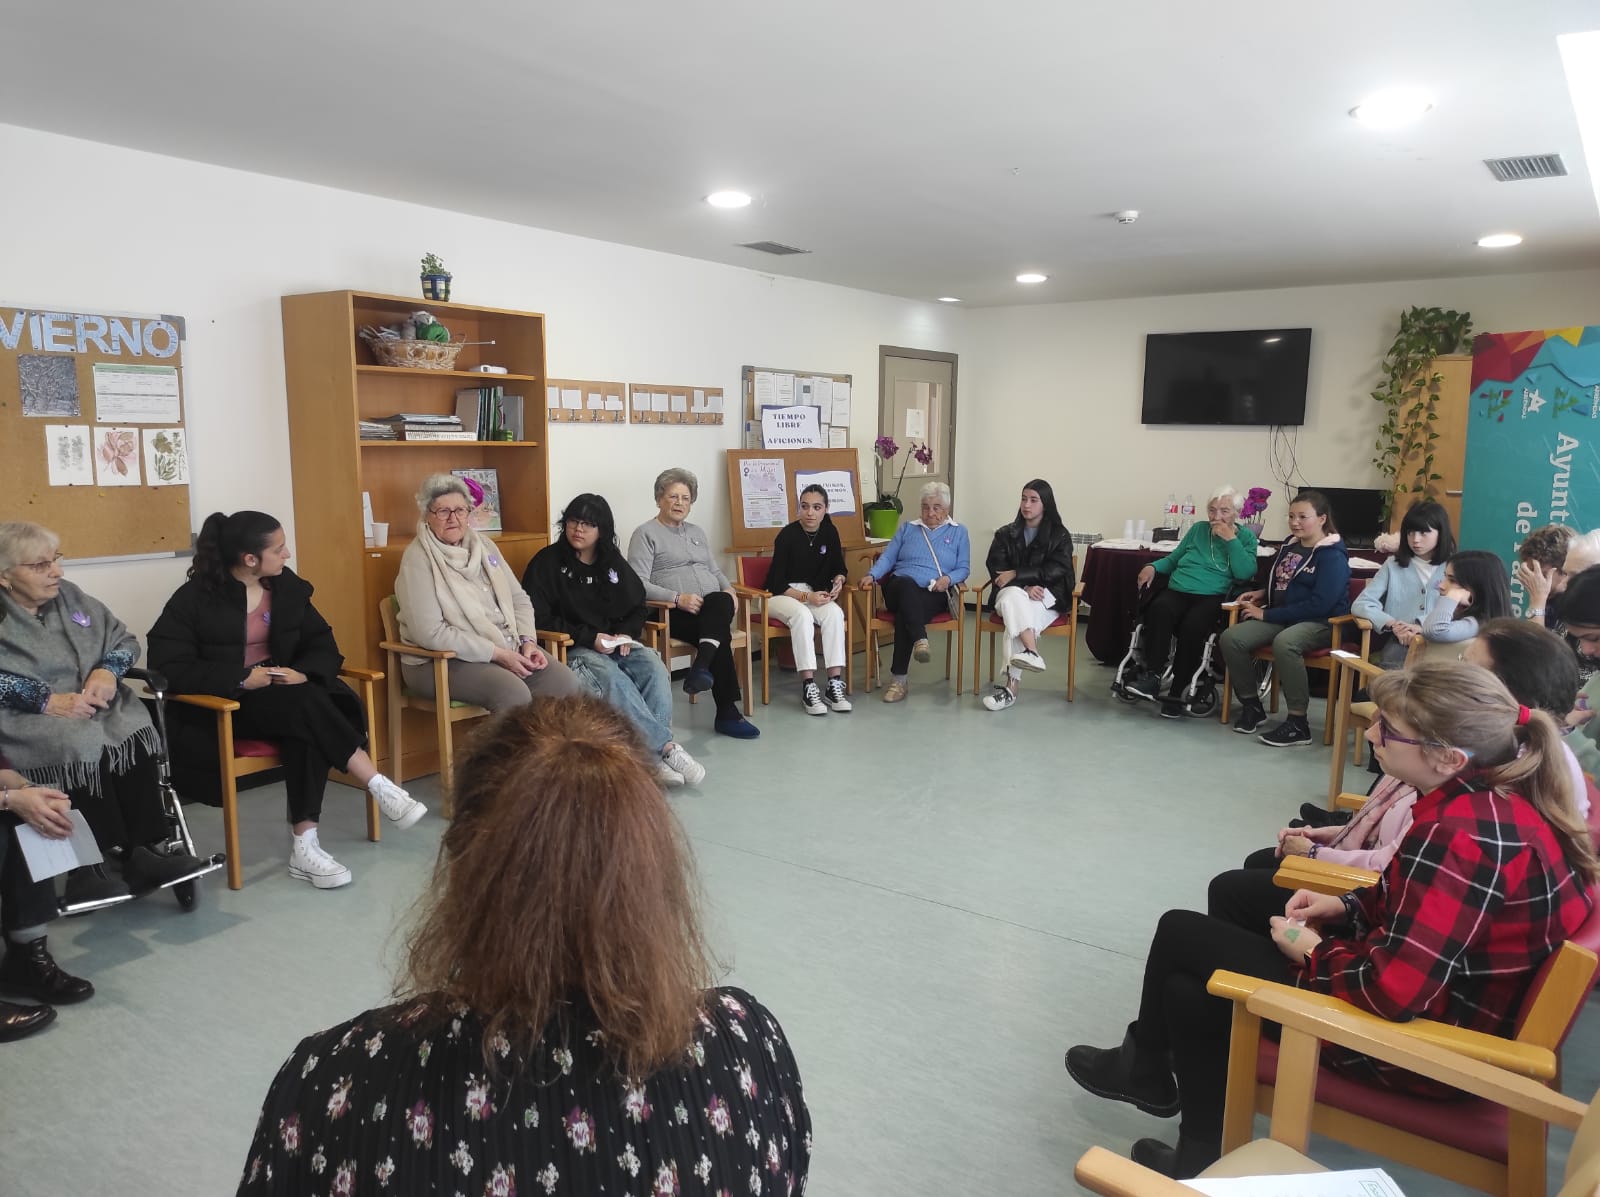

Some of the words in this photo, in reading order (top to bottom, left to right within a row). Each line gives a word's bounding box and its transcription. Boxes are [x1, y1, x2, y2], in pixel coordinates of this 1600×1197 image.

[0, 311, 178, 358] VIERNO
[1549, 431, 1580, 526] Ayunt
[1515, 501, 1538, 534] de
